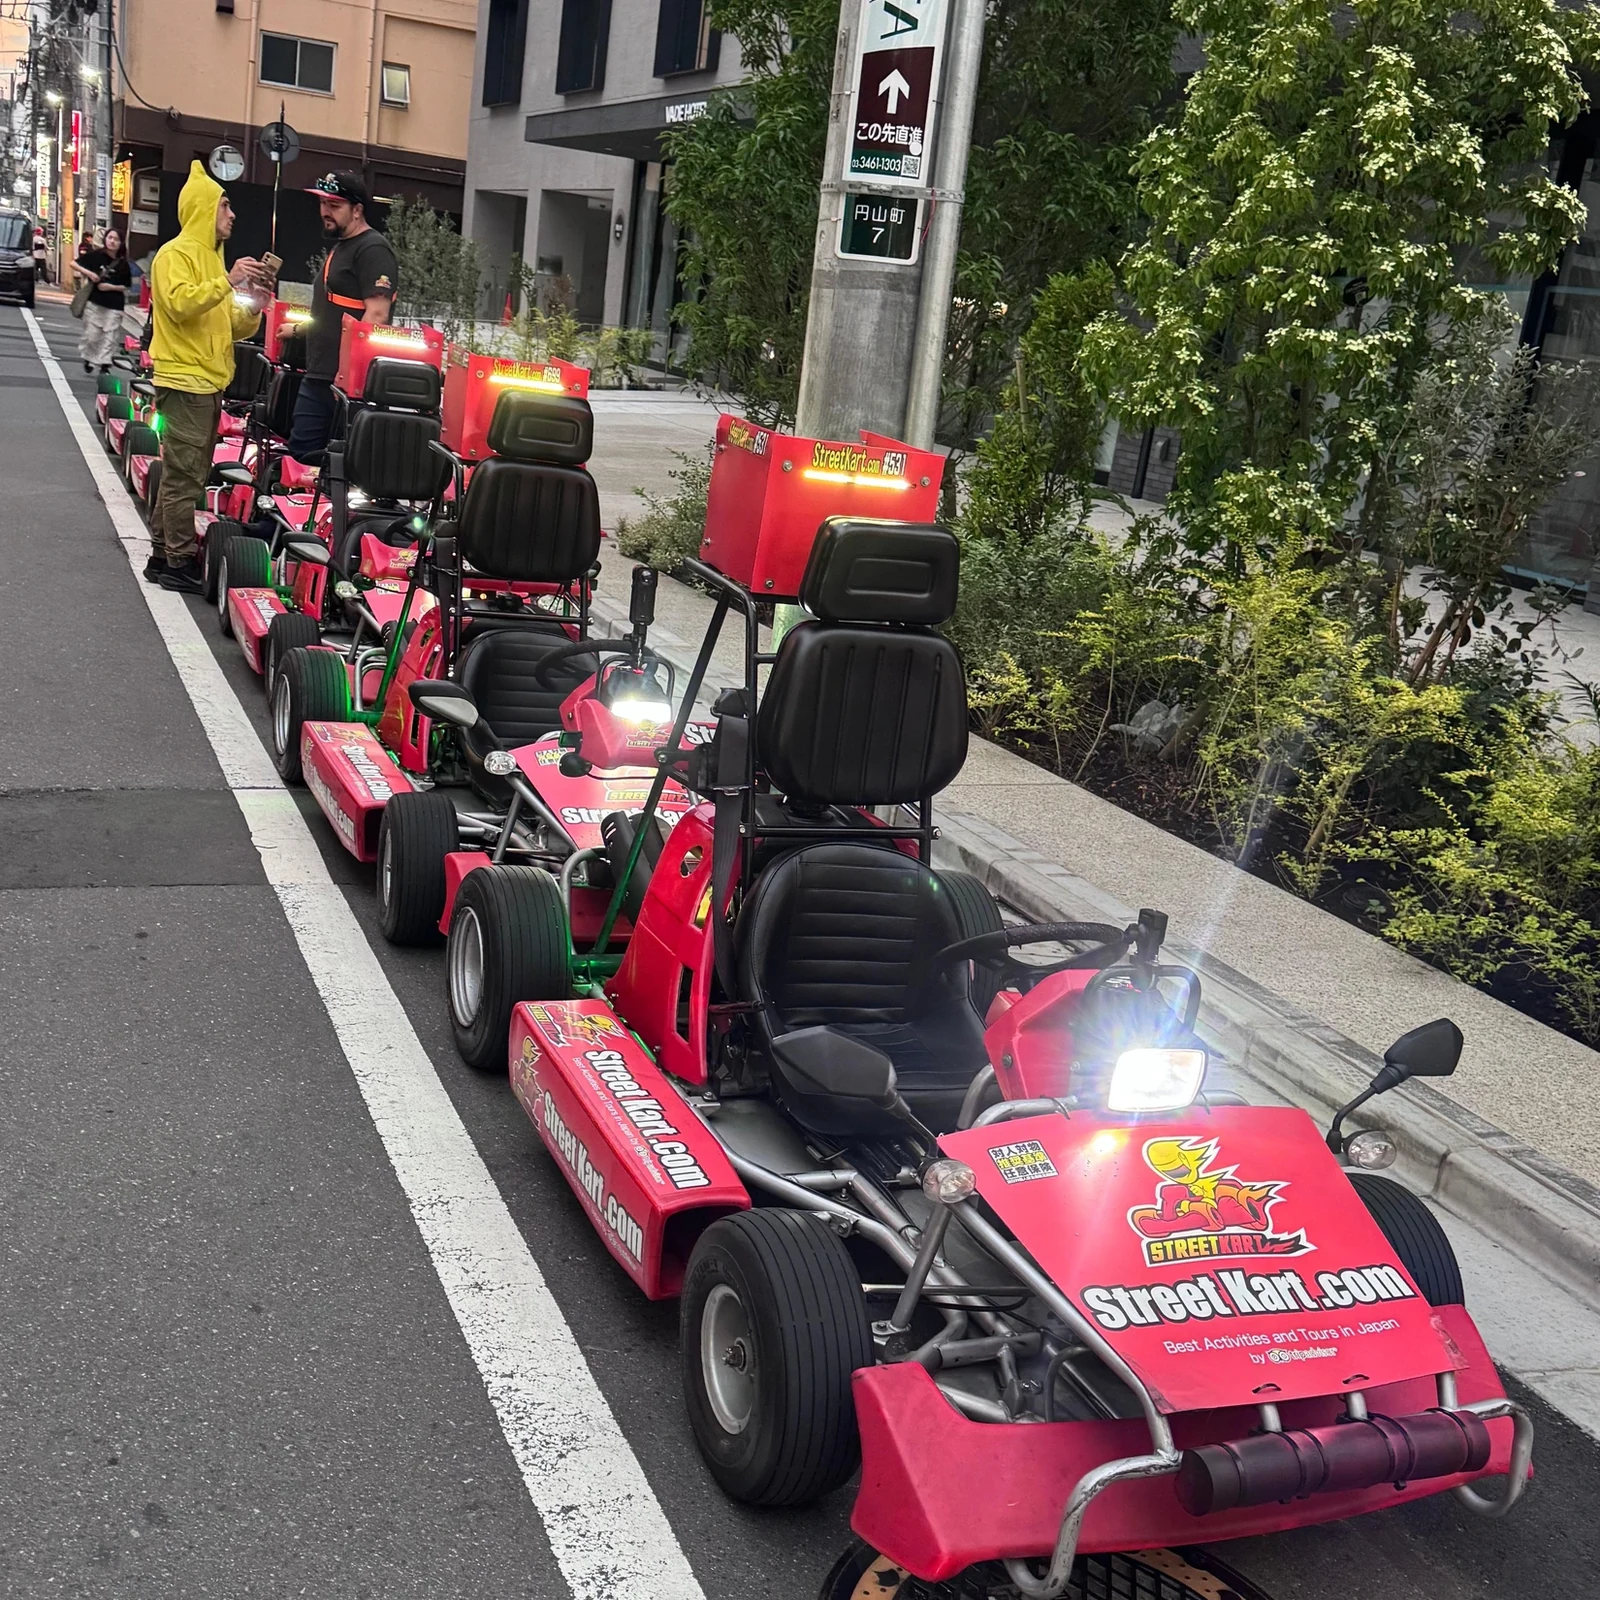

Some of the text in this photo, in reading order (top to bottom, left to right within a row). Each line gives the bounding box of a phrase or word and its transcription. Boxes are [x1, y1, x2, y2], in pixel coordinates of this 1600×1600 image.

[856, 122, 923, 146] この先直進
[851, 155, 901, 172] 03-3461-1303
[854, 204, 906, 225] 円山町
[871, 226, 885, 244] 7
[492, 358, 542, 381] StreetKart.com
[543, 366, 561, 383] #699
[812, 441, 908, 477] StreetKart.com #531
[584, 1049, 650, 1099] Street
[572, 1057, 584, 1070] Best
[581, 1066, 602, 1095] Activities
[604, 1099, 619, 1118] Tours
[617, 1119, 634, 1140] Japan
[544, 1090, 578, 1172] Street
[991, 1141, 1041, 1159] 対人対物
[1003, 1162, 1054, 1179] 任意保険
[1082, 1273, 1229, 1331] Street
[1162, 1317, 1400, 1354] Best Activities and Tours in Japan
[1249, 1352, 1266, 1365] by
